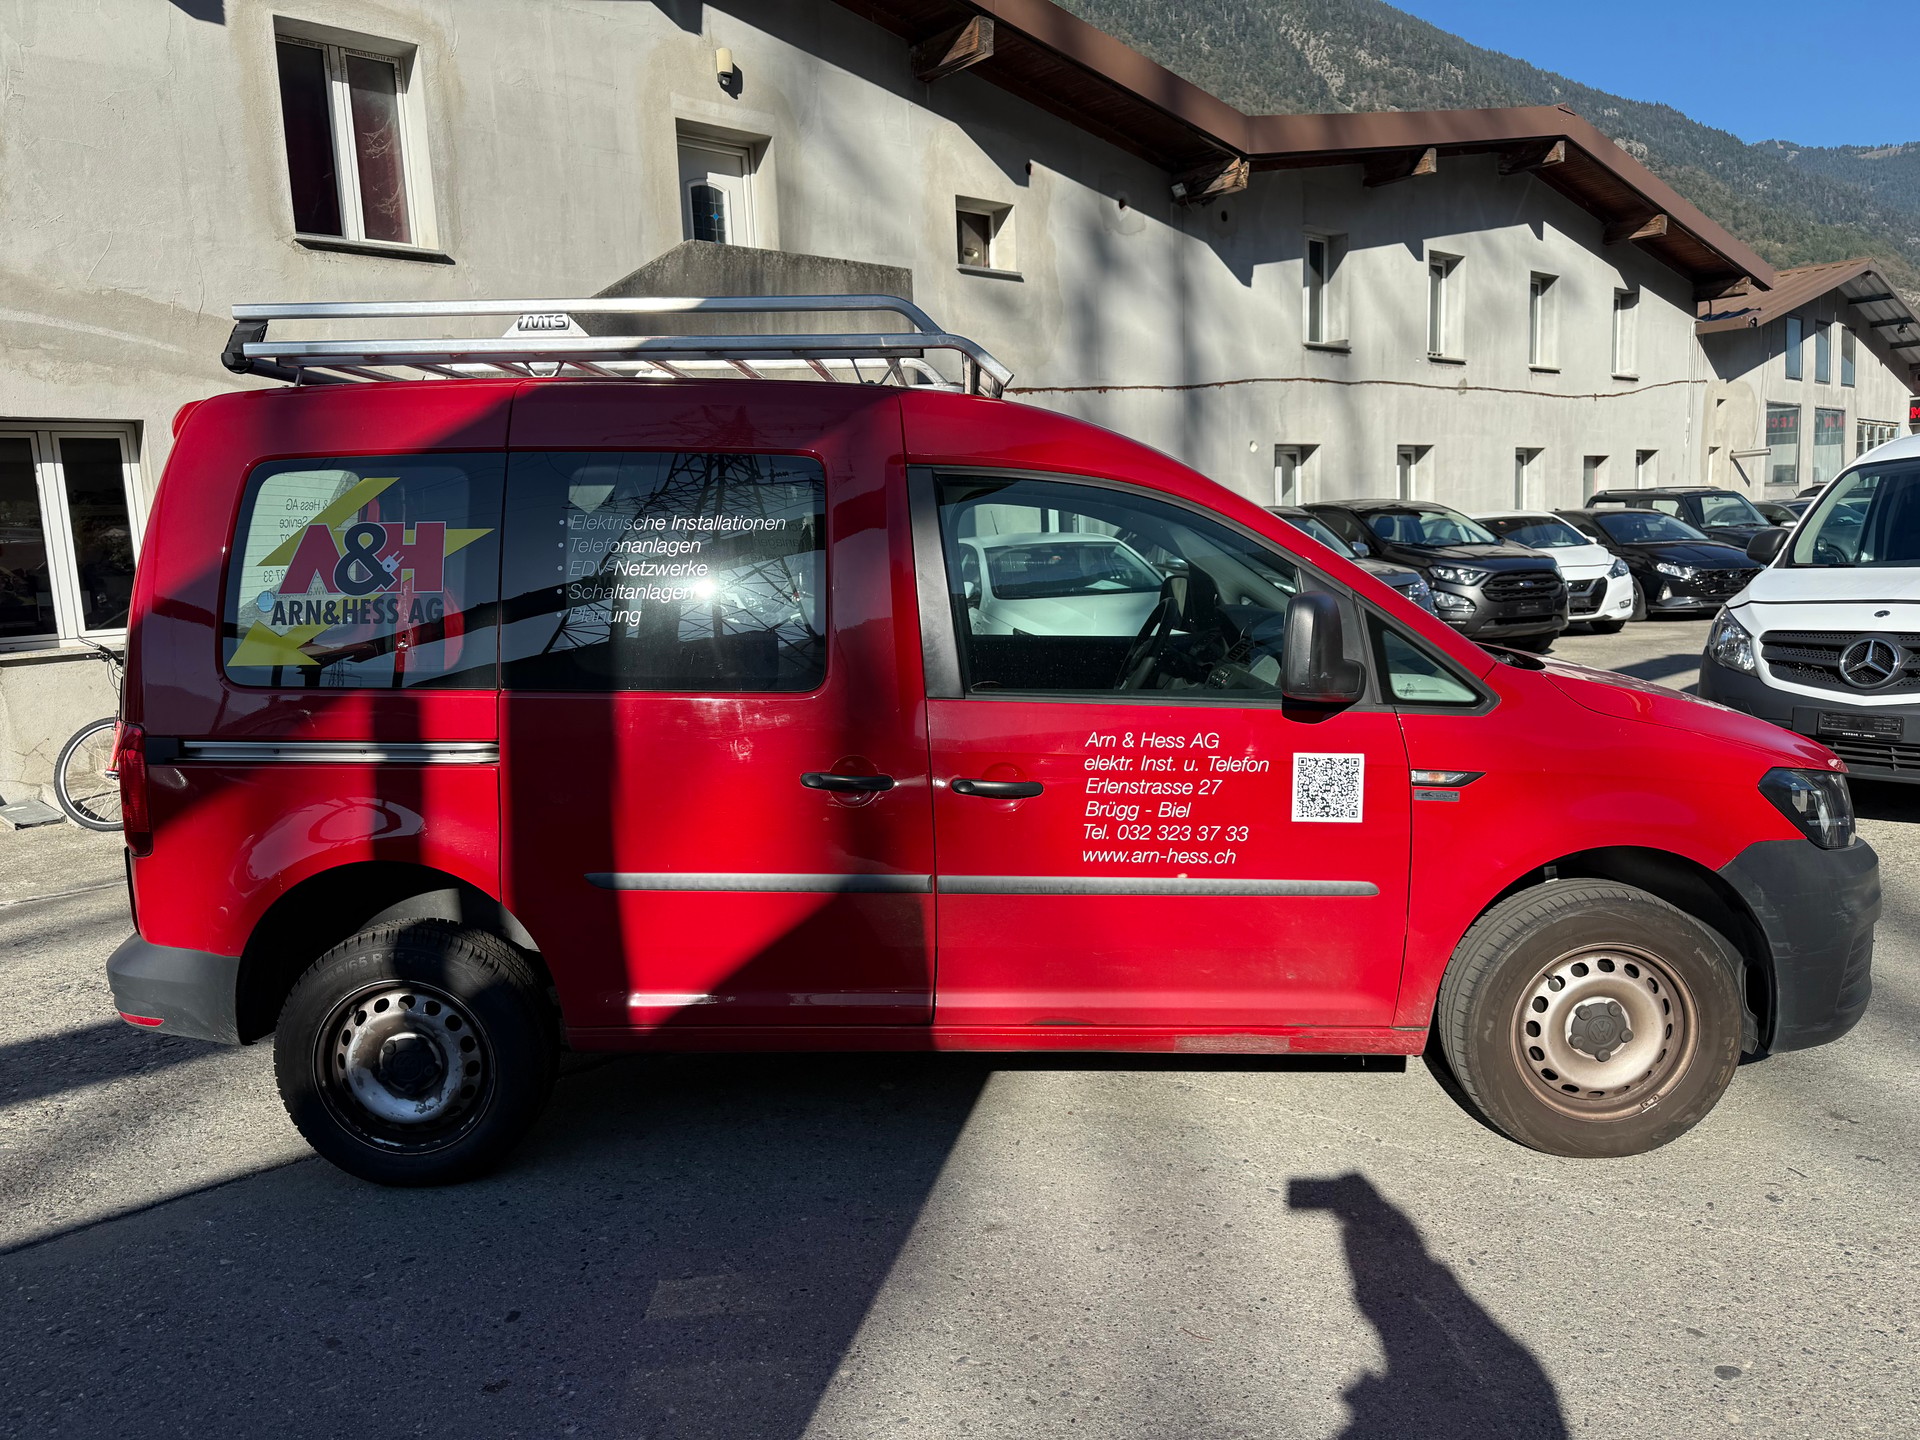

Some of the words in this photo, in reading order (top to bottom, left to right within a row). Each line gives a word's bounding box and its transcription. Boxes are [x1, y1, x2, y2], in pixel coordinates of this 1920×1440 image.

[525, 315, 566, 329] MTS
[570, 514, 666, 531] Elektrische
[671, 514, 786, 531] Installationen
[569, 537, 701, 557] Telefonanlagen
[569, 560, 708, 577] EDV-Netzwerke
[568, 583, 698, 602] Schaltanlagen
[271, 597, 399, 626] ARN&HESS
[407, 598, 444, 624] AG
[568, 607, 641, 627] Planung
[1085, 732, 1116, 748] Arn
[1122, 732, 1135, 748] &
[1140, 732, 1185, 748] Hess
[1190, 733, 1220, 748] AG
[1084, 755, 1133, 771] elektr.
[1141, 755, 1176, 772] Inst.
[1184, 760, 1199, 772] u.
[1208, 755, 1270, 772] Telefon
[1085, 778, 1193, 795] Erlenstrasse
[1198, 779, 1223, 795] 27
[1085, 800, 1139, 821] Brügg
[1158, 801, 1191, 818] Biel
[1084, 824, 1110, 840] Tel.
[1117, 825, 1151, 841] 032
[1157, 825, 1191, 841] 323
[1197, 826, 1221, 842] 37
[1225, 826, 1249, 842] 33
[1083, 848, 1236, 864] www.arn-hess.ch
